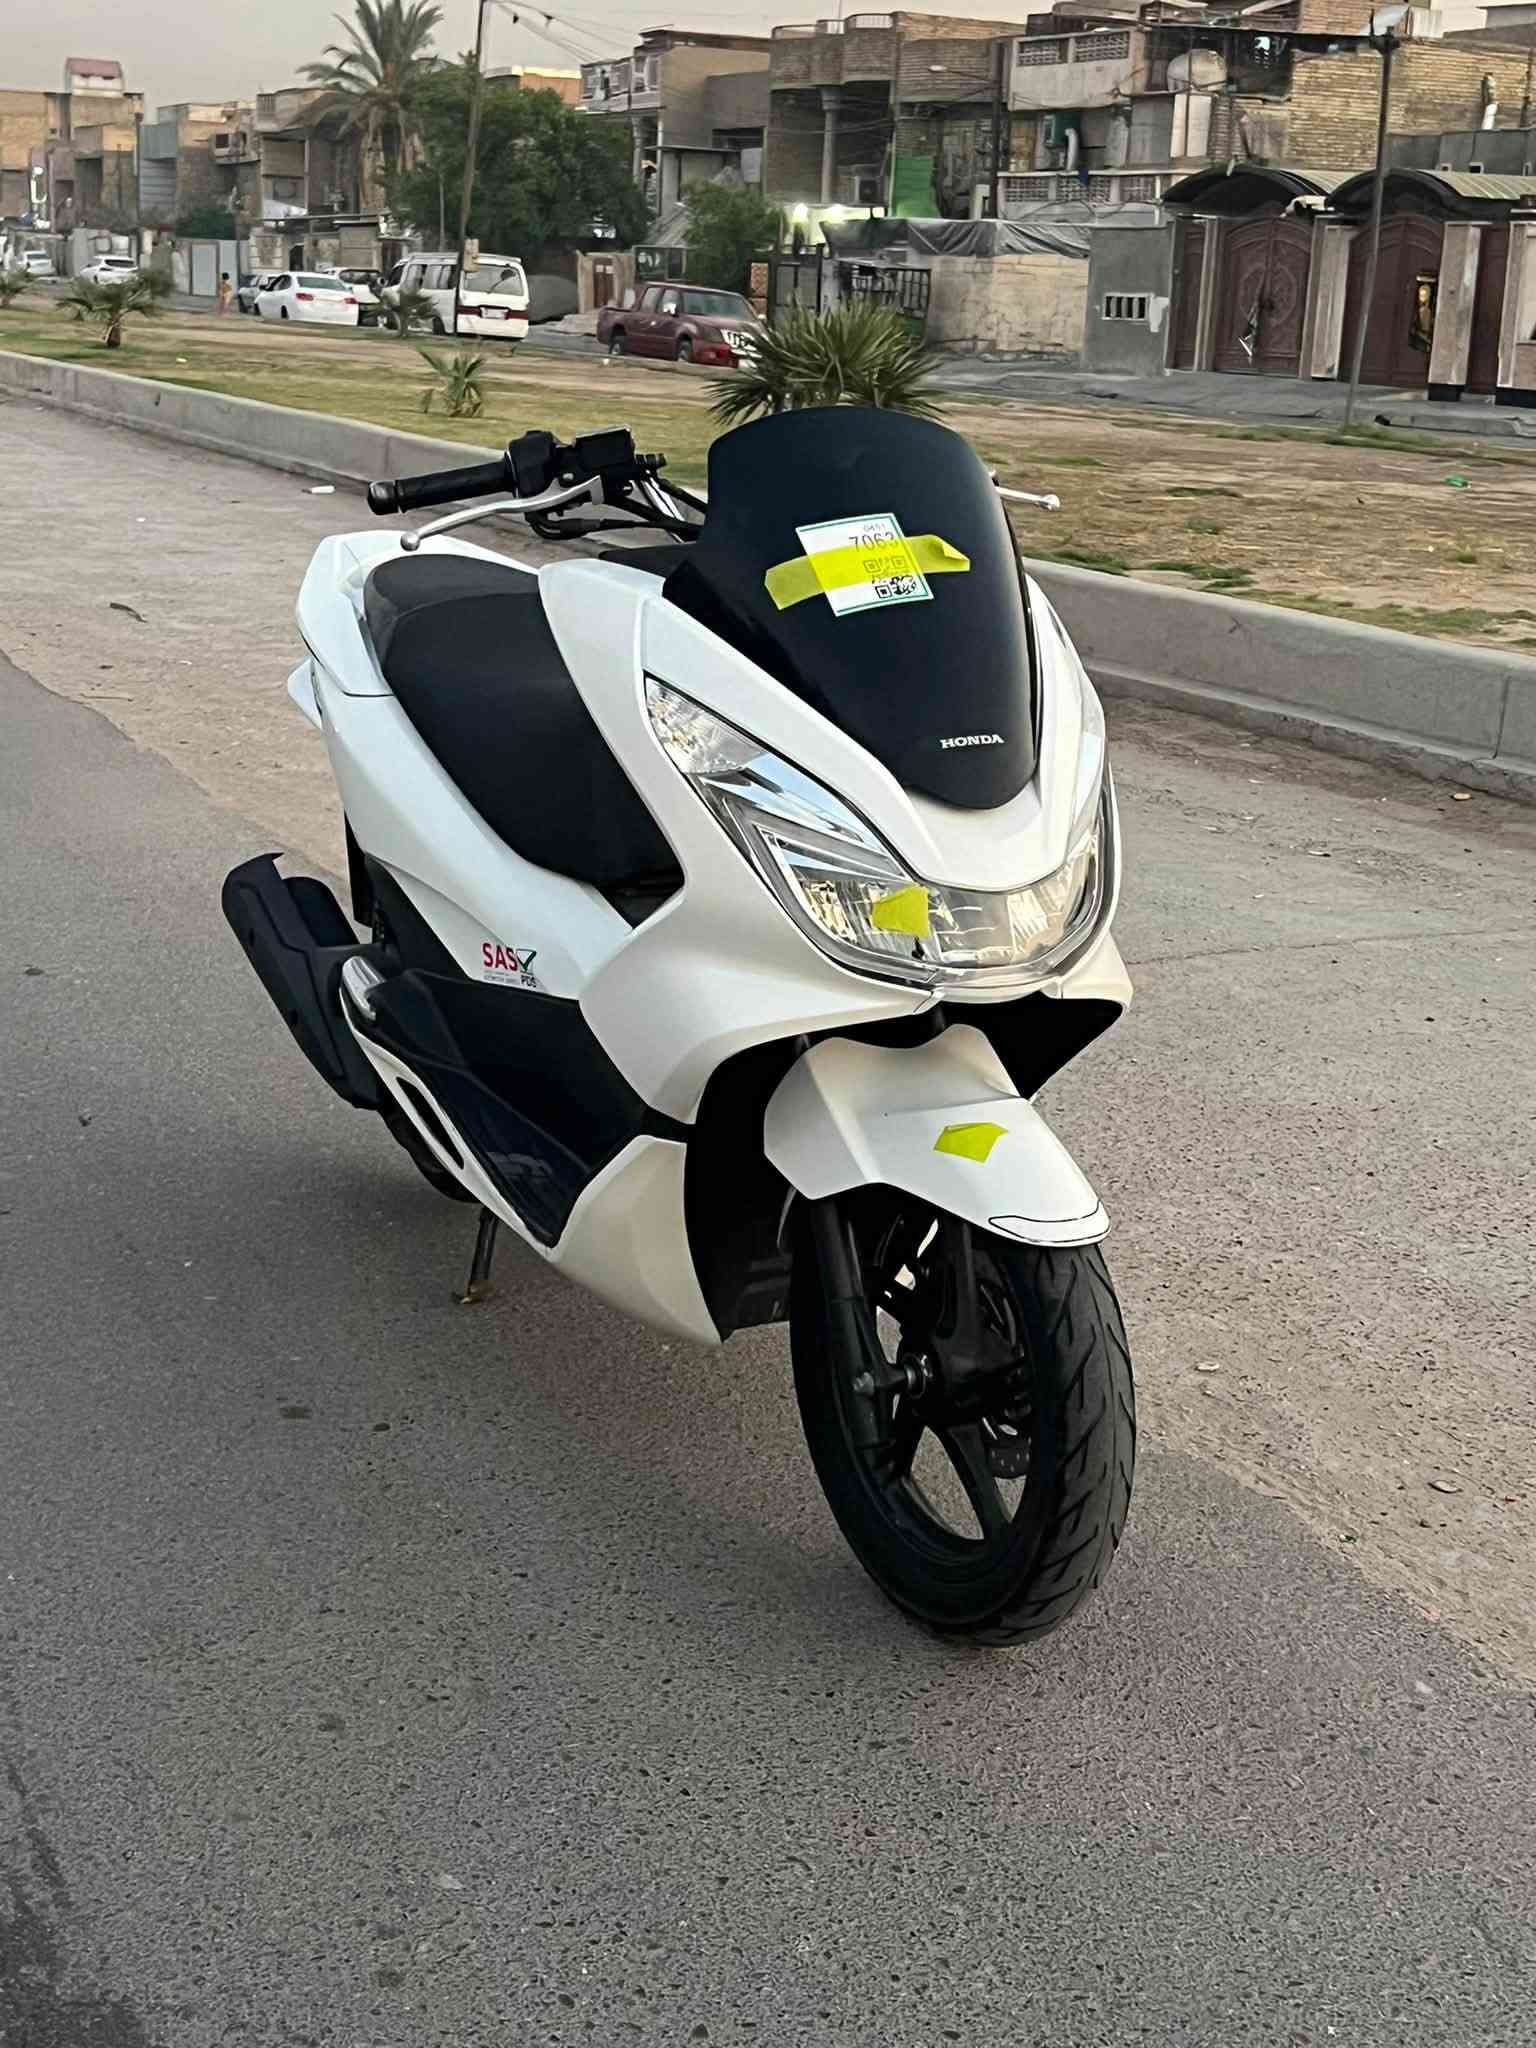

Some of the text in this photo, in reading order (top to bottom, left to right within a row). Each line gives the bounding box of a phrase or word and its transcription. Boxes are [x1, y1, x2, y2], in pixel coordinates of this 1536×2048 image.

[848, 531, 899, 552] 7063
[939, 734, 1005, 749] HONDA
[482, 942, 518, 972] SAS
